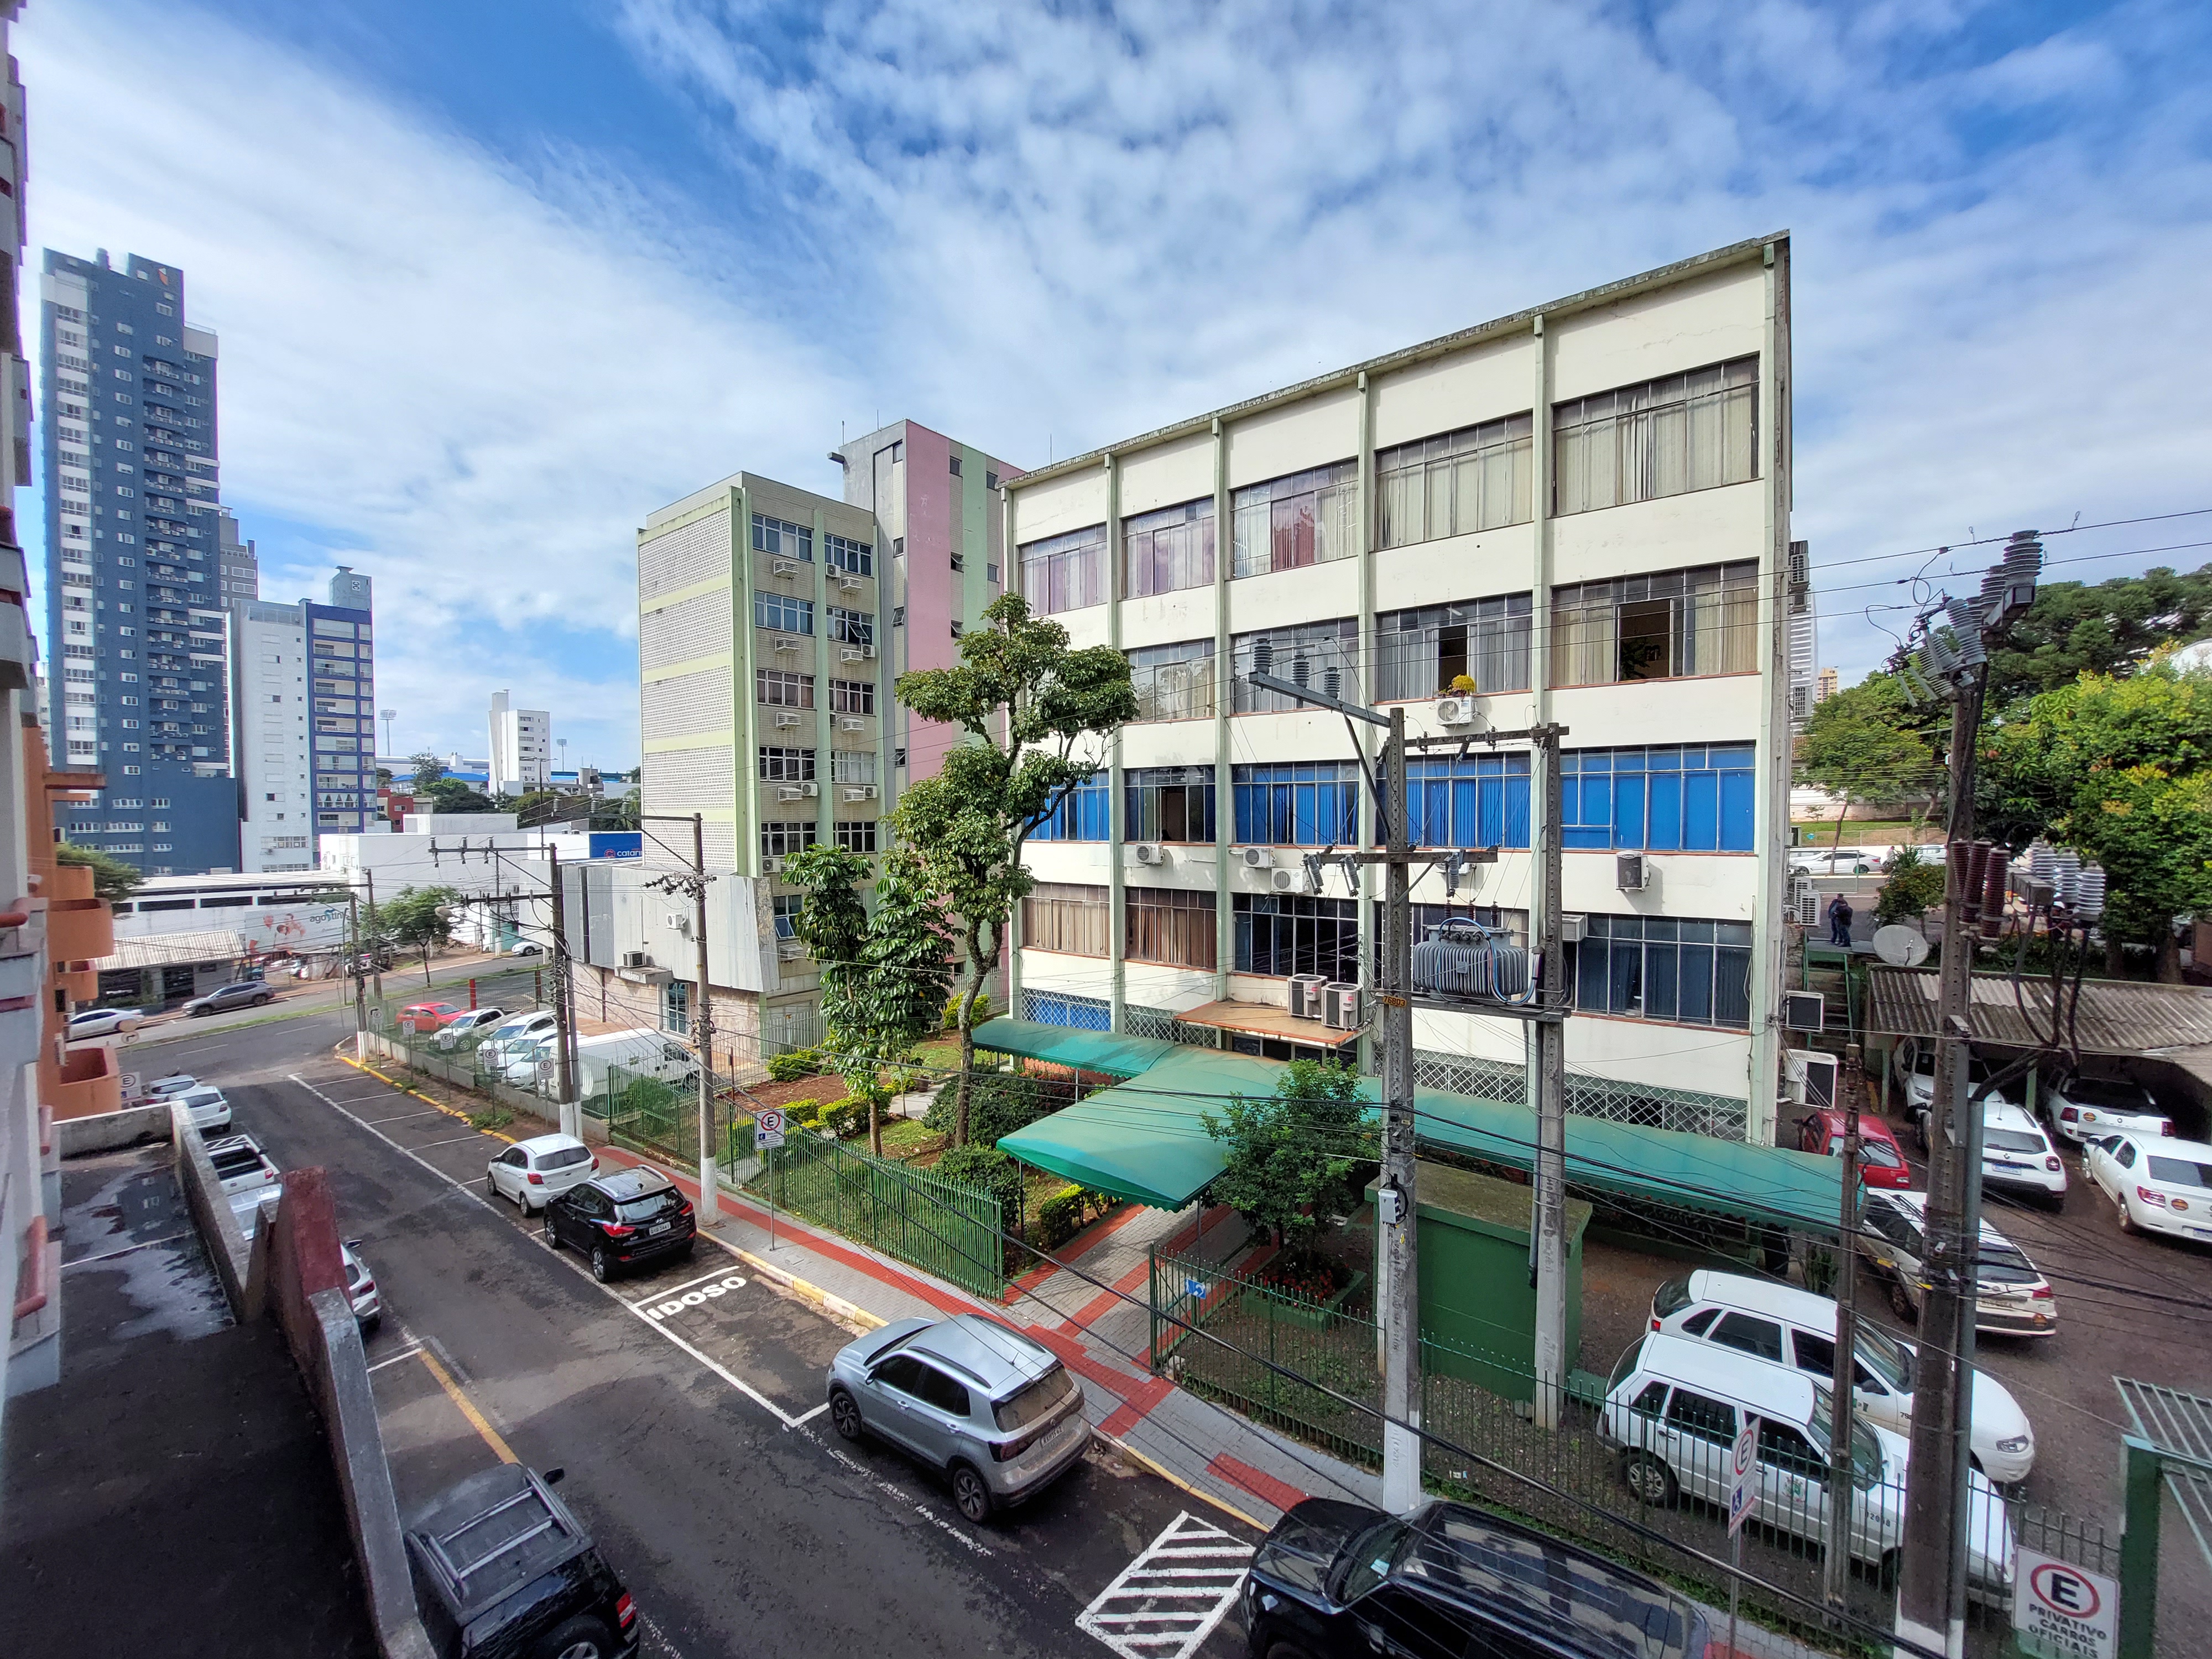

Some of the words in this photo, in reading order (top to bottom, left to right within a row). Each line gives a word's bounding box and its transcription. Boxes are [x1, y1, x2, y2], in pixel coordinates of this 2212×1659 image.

[1384, 996, 1405, 1006] 76803
[768, 1117, 774, 1126] E
[646, 1276, 747, 1320] IDOSO
[1740, 1439, 1749, 1465] E
[2052, 1572, 2080, 1611] E
[2029, 1603, 2107, 1640] PRIVATIVO
[2039, 1619, 2096, 1647] CARROS
[2028, 1624, 2098, 1658] OFICIAIS
